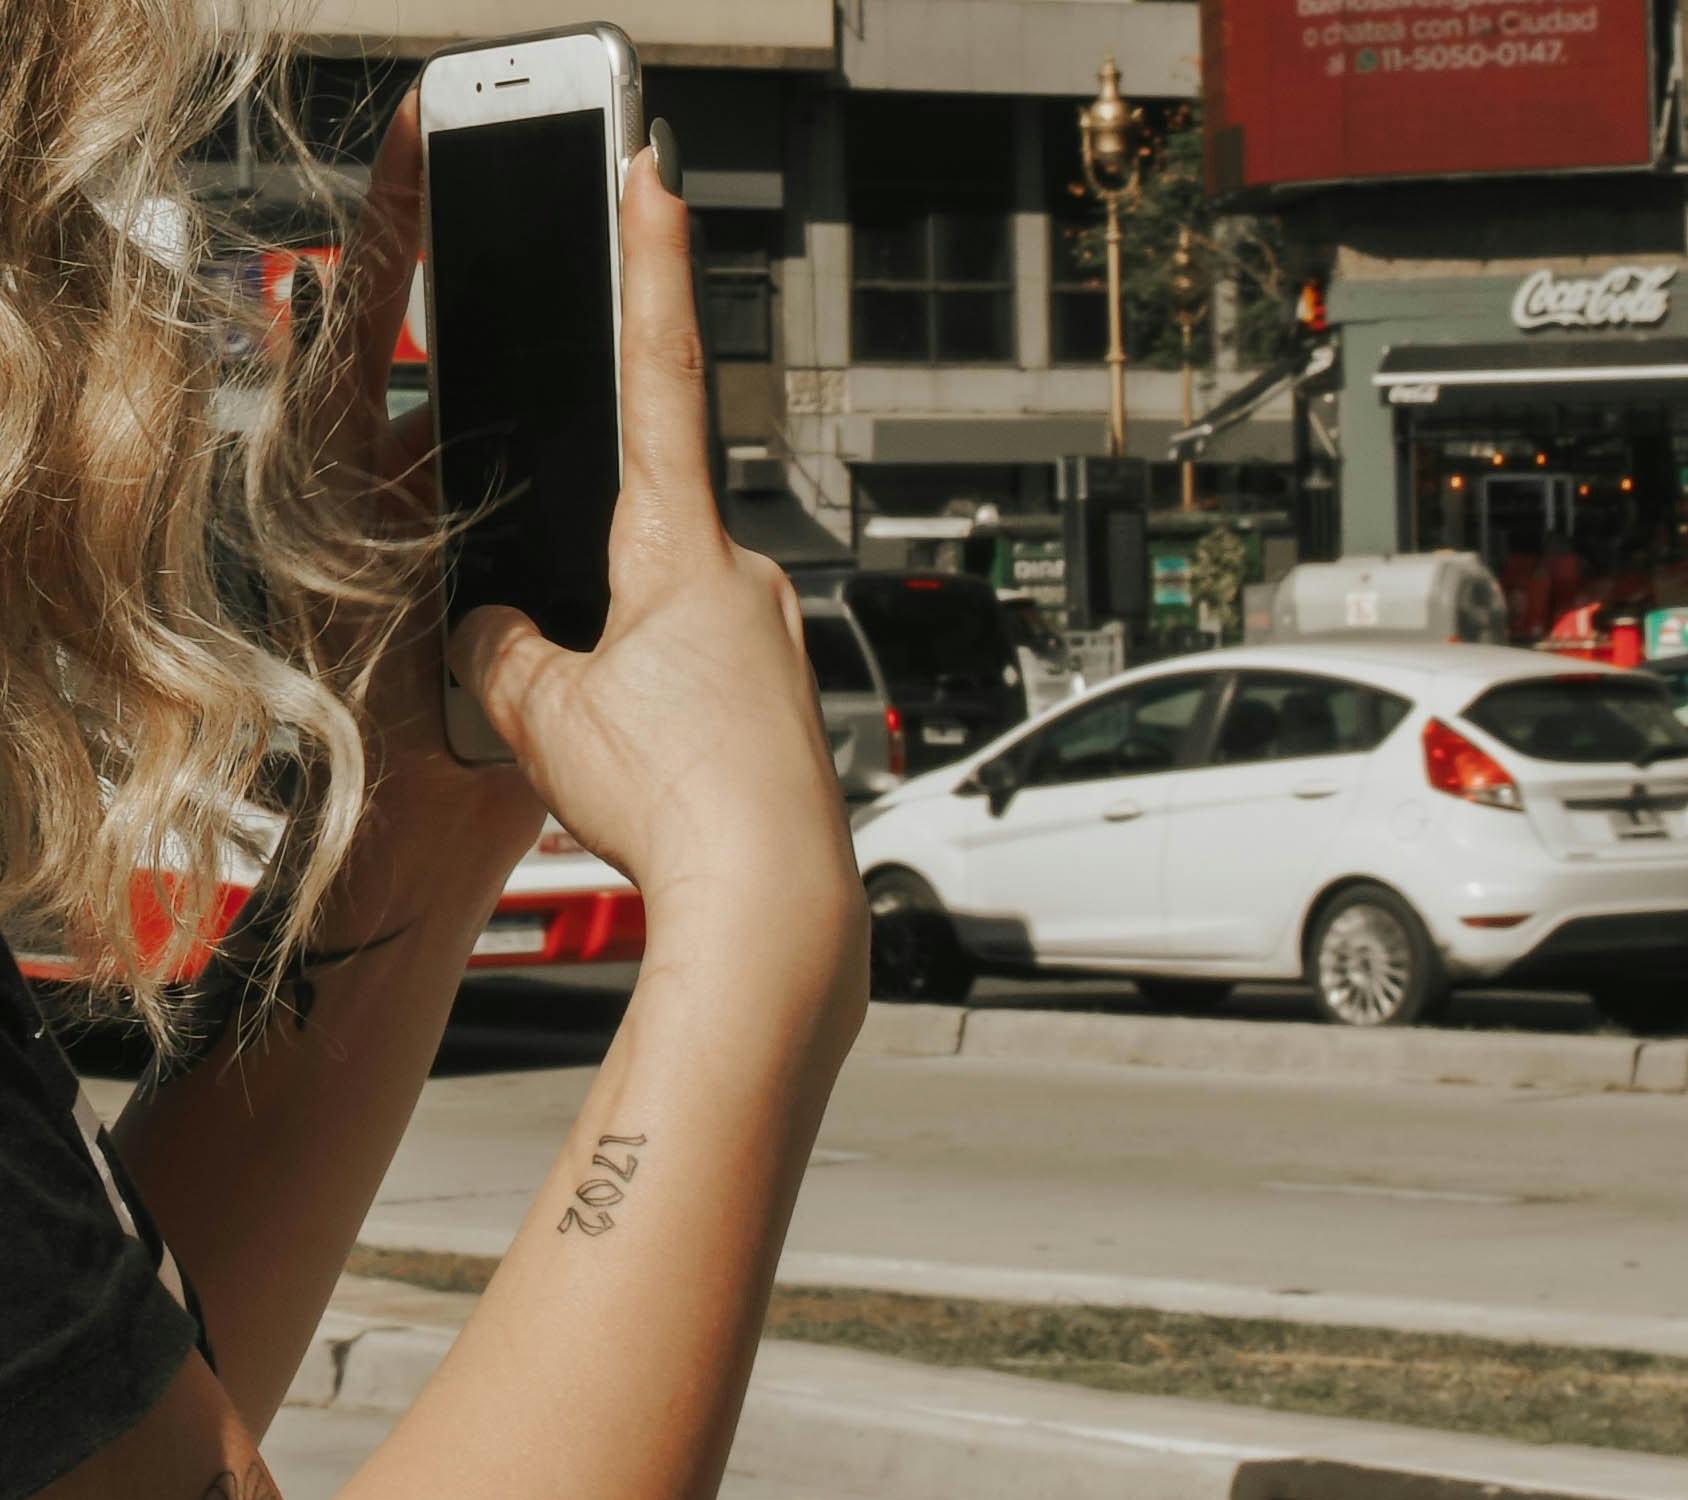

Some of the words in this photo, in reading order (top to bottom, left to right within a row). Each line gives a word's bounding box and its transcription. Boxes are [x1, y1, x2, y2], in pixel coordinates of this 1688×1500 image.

[1302, 27, 1318, 48] o
[1412, 17, 1462, 41] con
[1498, 5, 1598, 36] Ciudad
[1512, 264, 1678, 330] Coca-Cola
